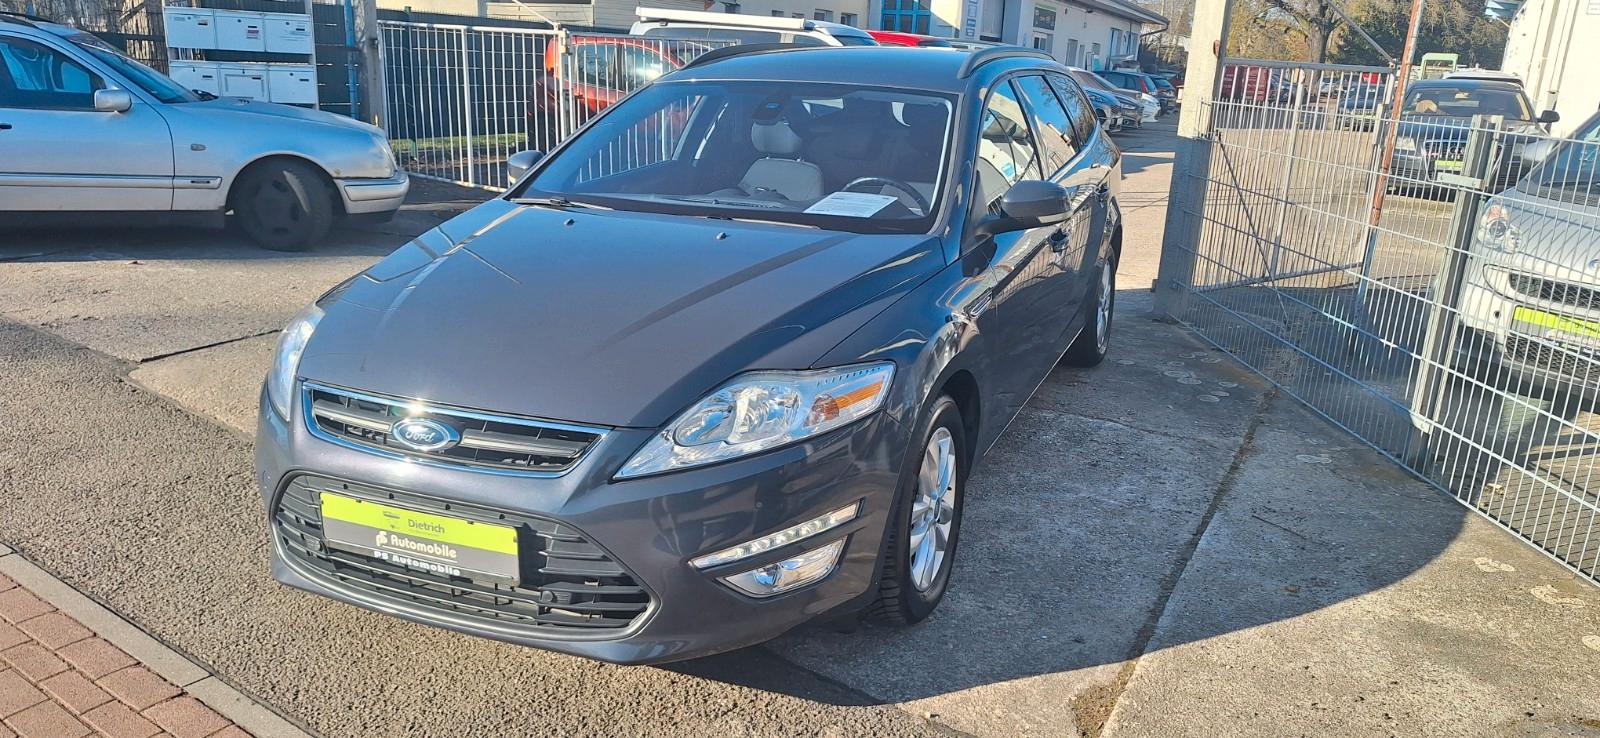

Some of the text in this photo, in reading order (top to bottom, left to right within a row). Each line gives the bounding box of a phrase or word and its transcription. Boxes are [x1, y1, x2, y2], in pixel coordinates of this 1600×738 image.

[405, 428, 436, 442] Ford
[408, 519, 445, 533] Dietrich
[390, 534, 457, 558] Automobile
[374, 550, 461, 576] PS Automobile
